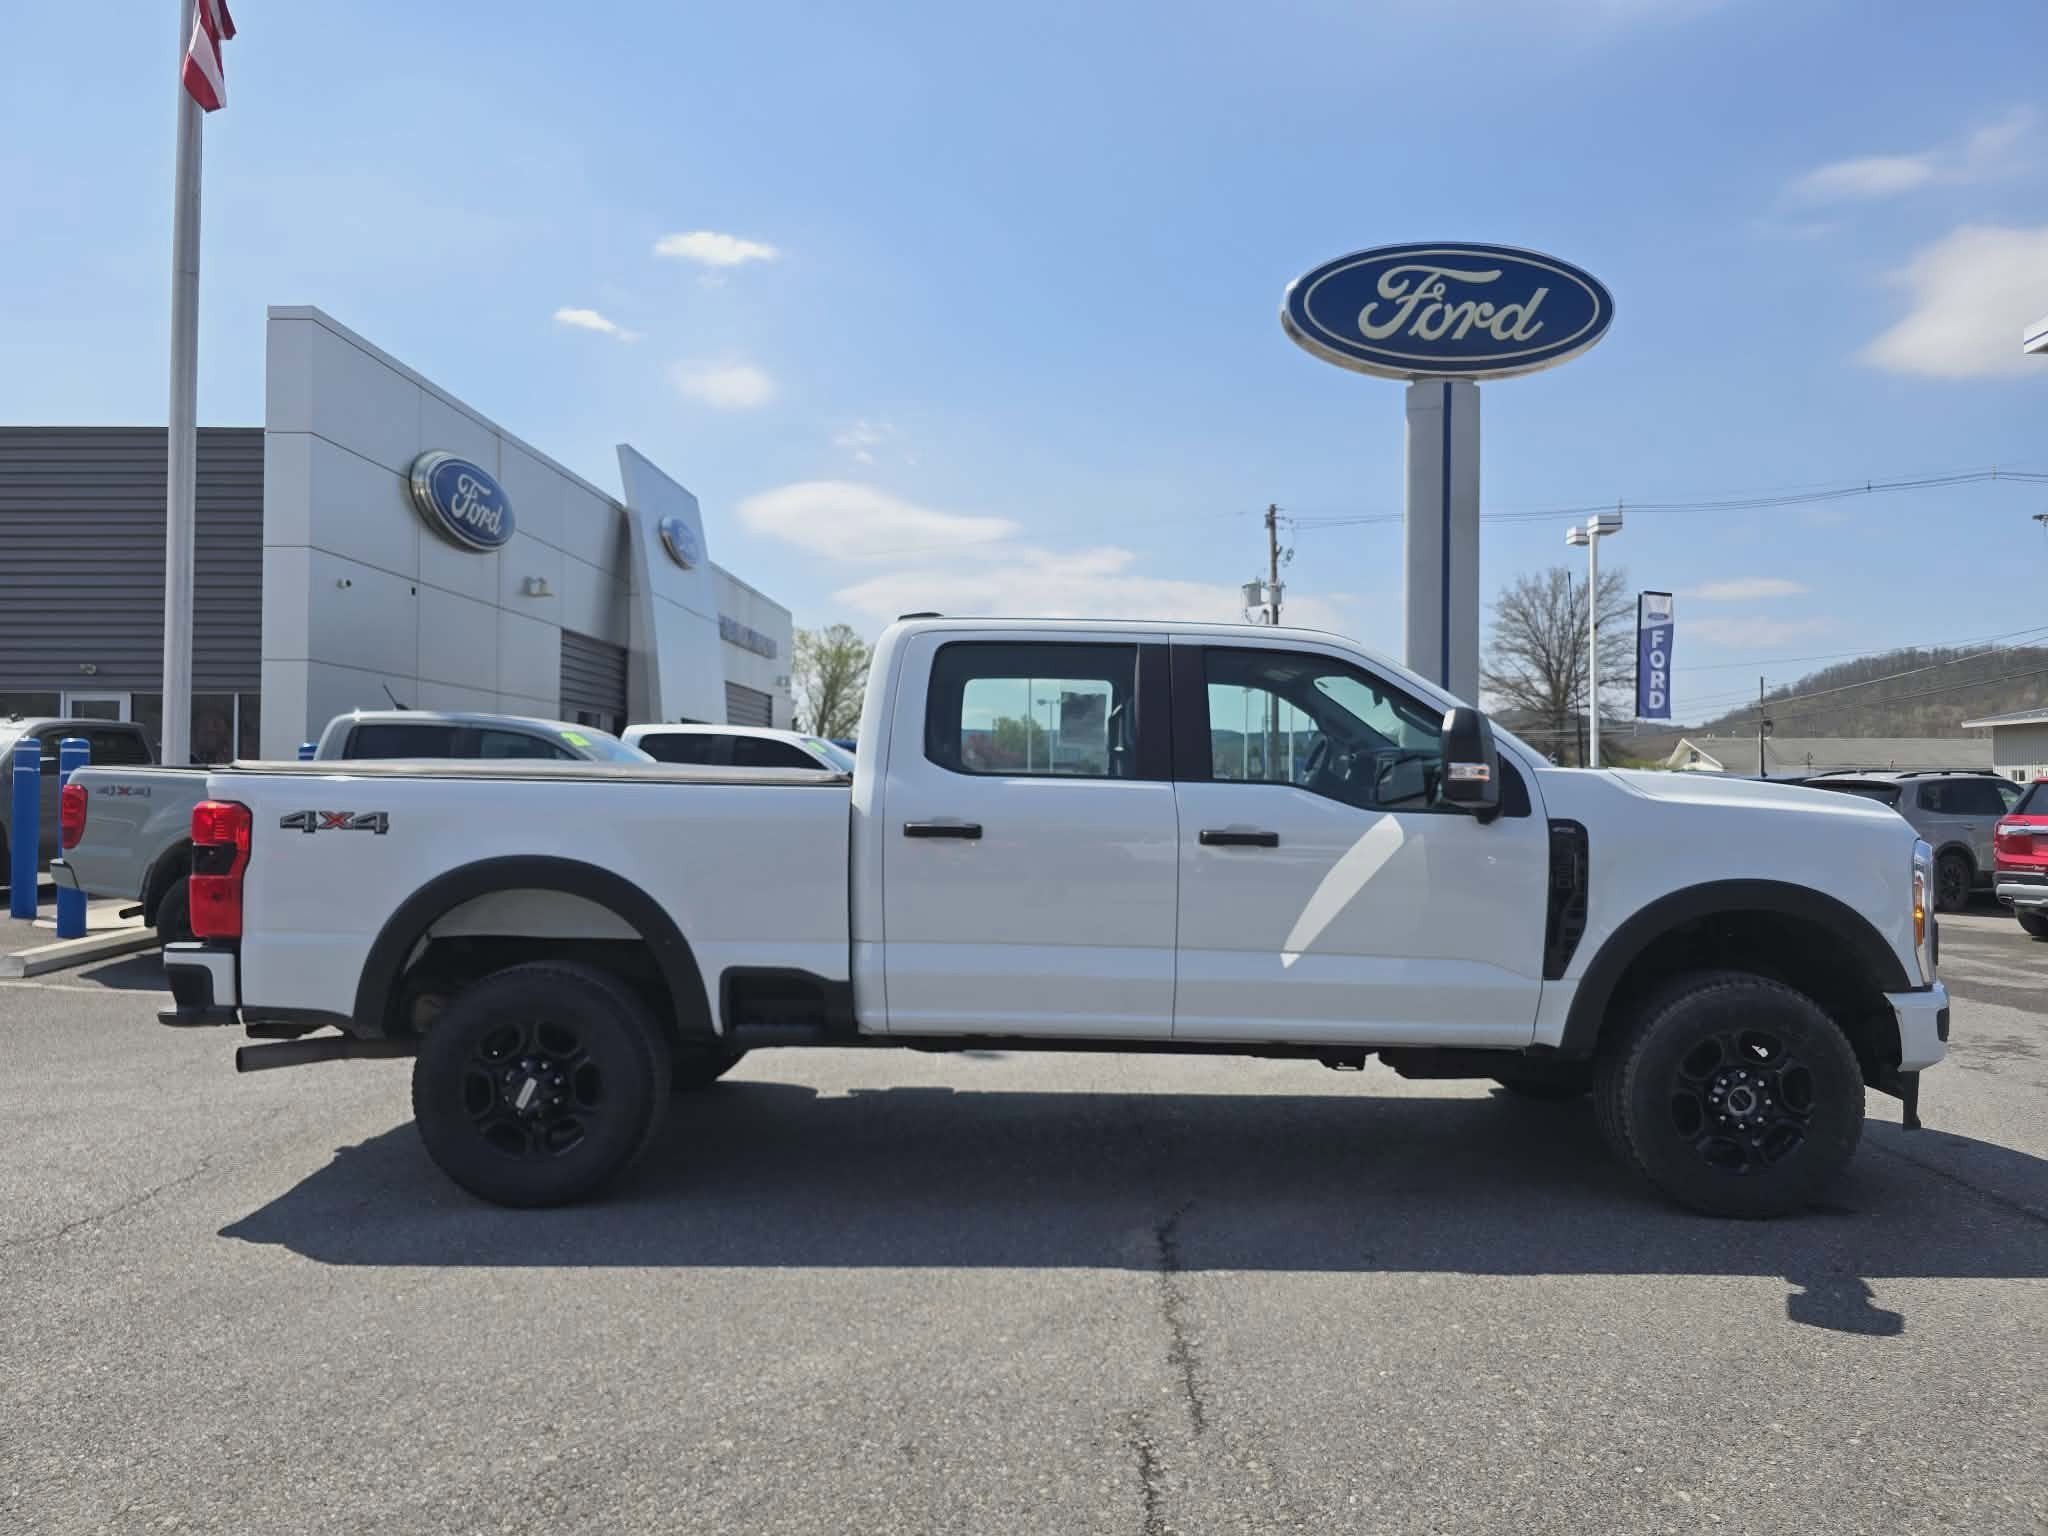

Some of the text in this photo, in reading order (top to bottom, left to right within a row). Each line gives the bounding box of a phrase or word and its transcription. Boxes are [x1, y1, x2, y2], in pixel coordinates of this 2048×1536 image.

[1358, 265, 1549, 341] Ford
[451, 473, 503, 535] Ford
[1648, 630, 1666, 709] FORD
